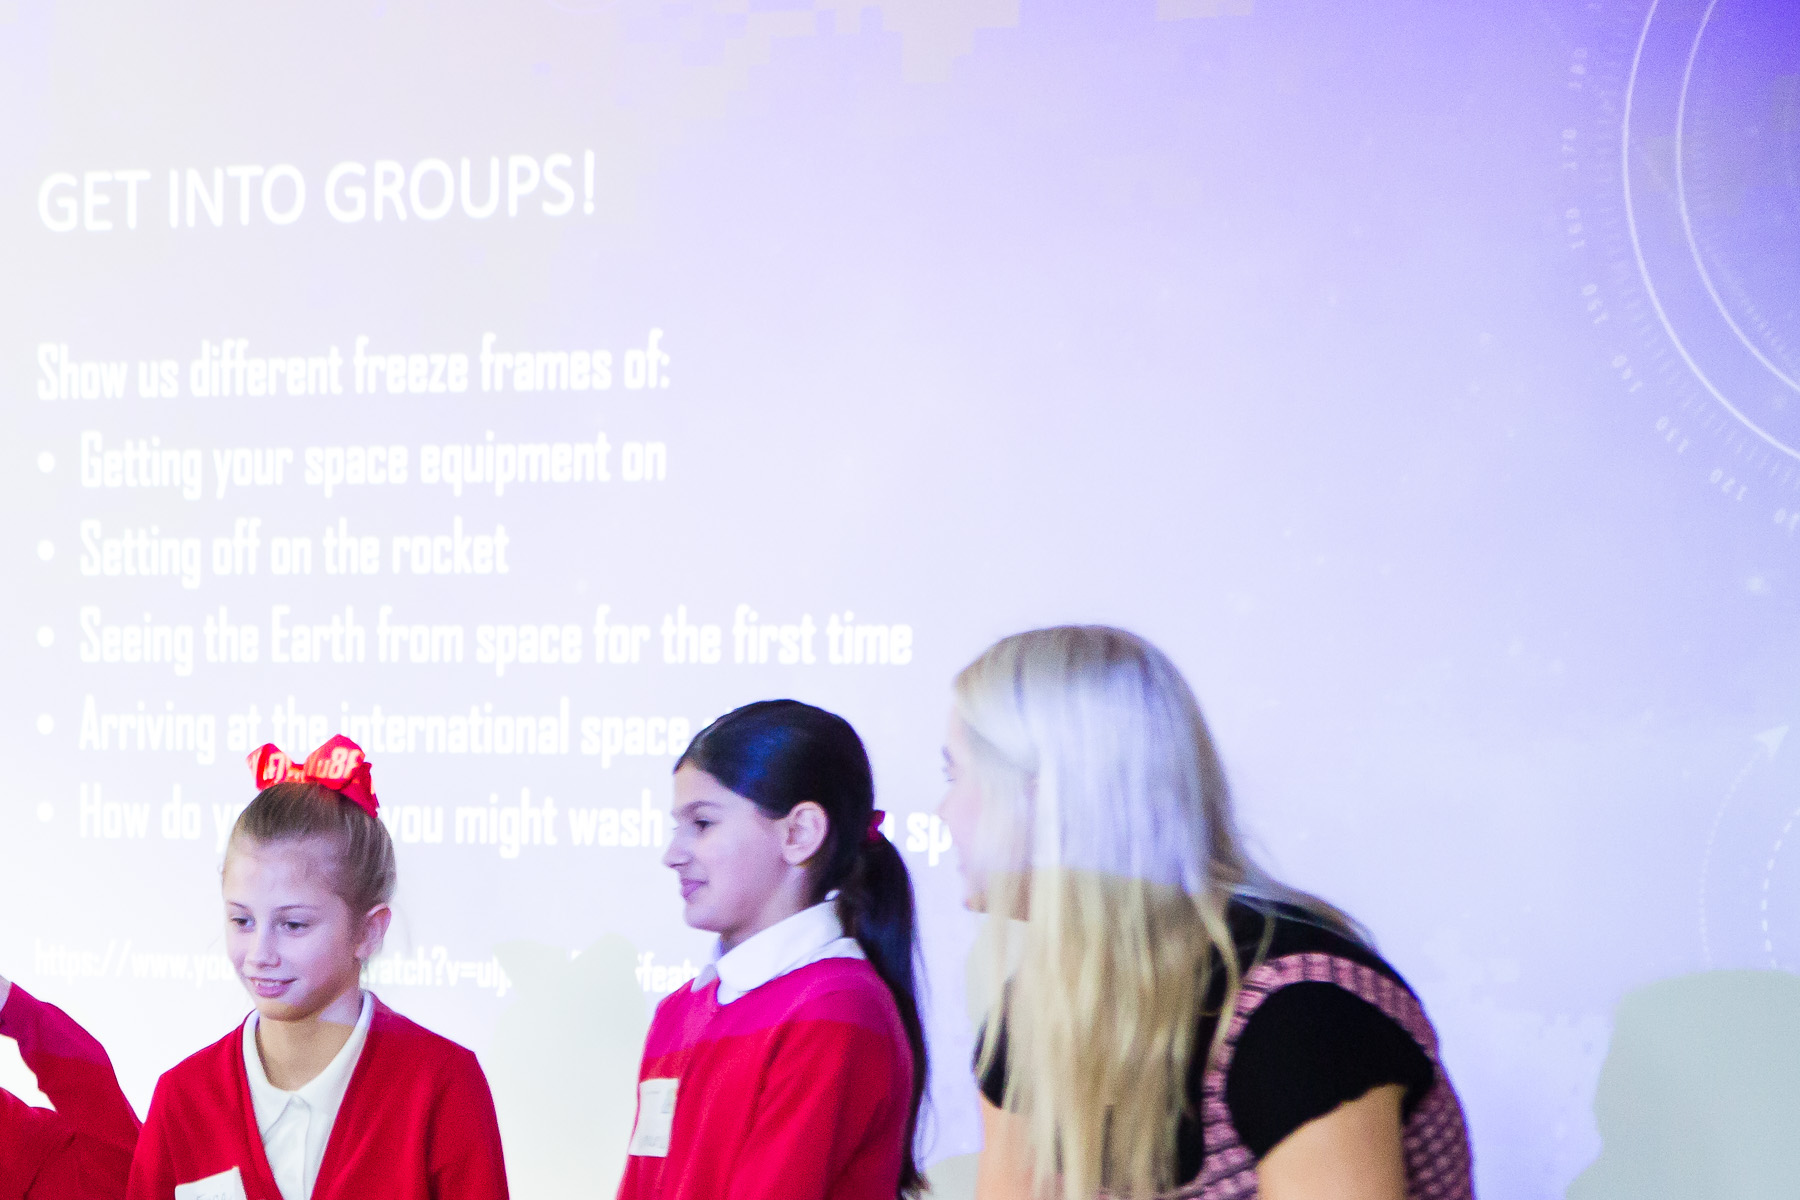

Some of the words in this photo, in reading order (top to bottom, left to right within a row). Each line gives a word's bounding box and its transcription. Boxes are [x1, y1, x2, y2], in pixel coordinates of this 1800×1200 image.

[38, 169, 151, 233] GET
[169, 163, 306, 228] INTO
[324, 149, 595, 223] GROUPS!
[37, 342, 128, 401] Show
[138, 359, 179, 398] us
[190, 338, 343, 397] different
[352, 334, 469, 394] freeze
[479, 331, 613, 392] frames
[623, 328, 670, 390] of:
[81, 430, 203, 500] Getting
[213, 447, 294, 500] your
[304, 445, 409, 499] space
[420, 430, 612, 497] equipment
[621, 441, 667, 482] on
[80, 519, 202, 590] Setting
[212, 517, 262, 575] off
[270, 537, 312, 575] on
[322, 516, 380, 575] the
[392, 515, 510, 574] rocket
[80, 605, 194, 677] Seeing
[203, 606, 258, 664] the
[271, 604, 366, 663] Earth
[376, 605, 464, 663] from
[476, 624, 583, 677] space
[592, 603, 651, 664] for
[660, 607, 722, 664] the
[731, 603, 817, 665] first
[825, 610, 913, 665] time
[79, 693, 215, 764] Arriving
[228, 704, 265, 753] at
[272, 695, 330, 752] the
[339, 695, 570, 757] international
[580, 716, 690, 769] space
[79, 782, 151, 840] How
[161, 783, 202, 840] do
[455, 787, 558, 859] might
[569, 788, 661, 846] wash
